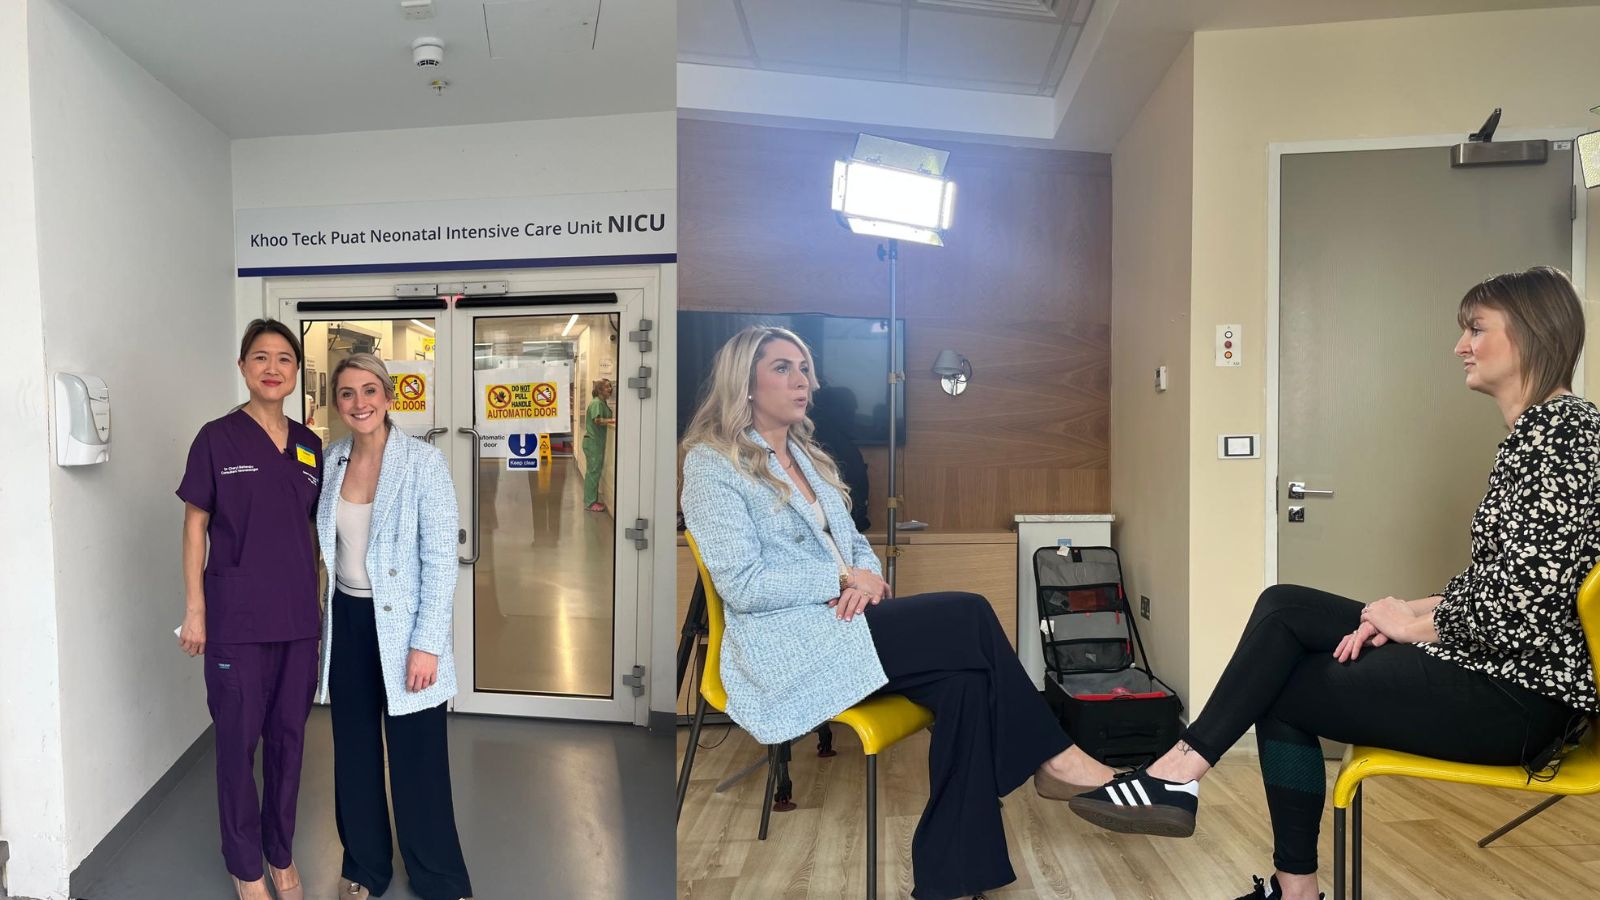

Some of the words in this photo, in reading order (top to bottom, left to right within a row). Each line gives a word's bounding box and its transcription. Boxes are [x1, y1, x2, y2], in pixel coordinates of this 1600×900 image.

[250, 233, 288, 247] Khoo
[292, 231, 327, 246] Teck
[331, 231, 366, 244] Puat
[370, 226, 441, 243] Neonatal
[446, 223, 520, 240] Intensive
[524, 222, 562, 237] Care
[567, 219, 602, 235] Unit
[608, 213, 665, 233] NICU
[520, 384, 531, 392] NOT
[402, 400, 426, 410] DOOR
[511, 400, 532, 408] HANDLE
[487, 408, 532, 419] AUTOMATIC
[534, 407, 557, 417] DOOR
